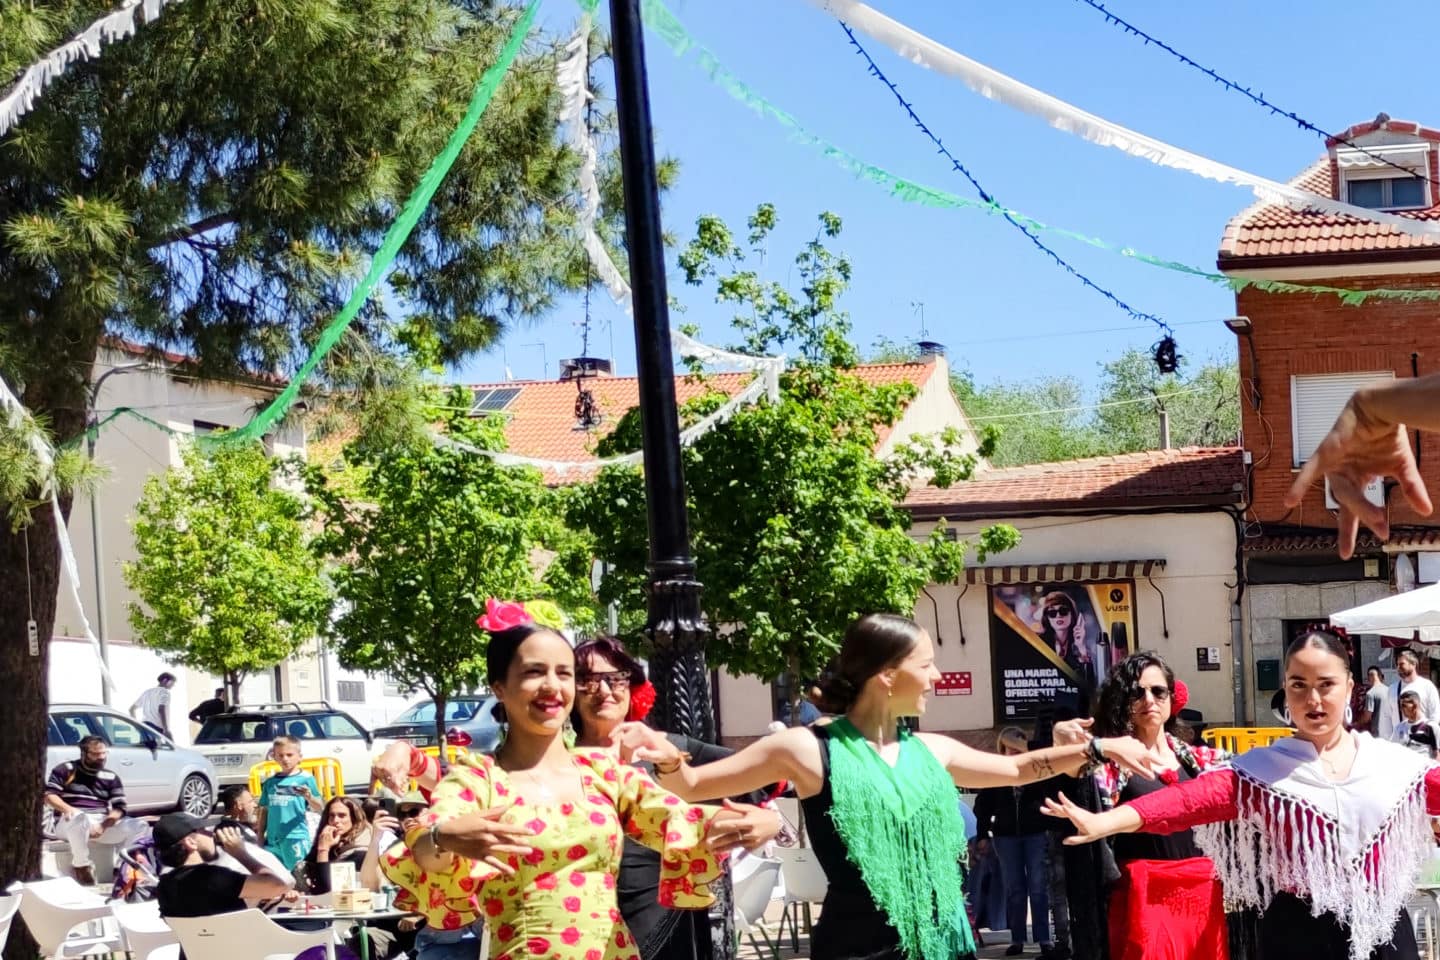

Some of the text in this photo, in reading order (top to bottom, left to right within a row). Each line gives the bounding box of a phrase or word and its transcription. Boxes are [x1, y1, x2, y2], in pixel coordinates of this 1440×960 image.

[1004, 668, 1058, 678] UNA MARCA
[1005, 678, 1066, 688] GLOBAL PARA
